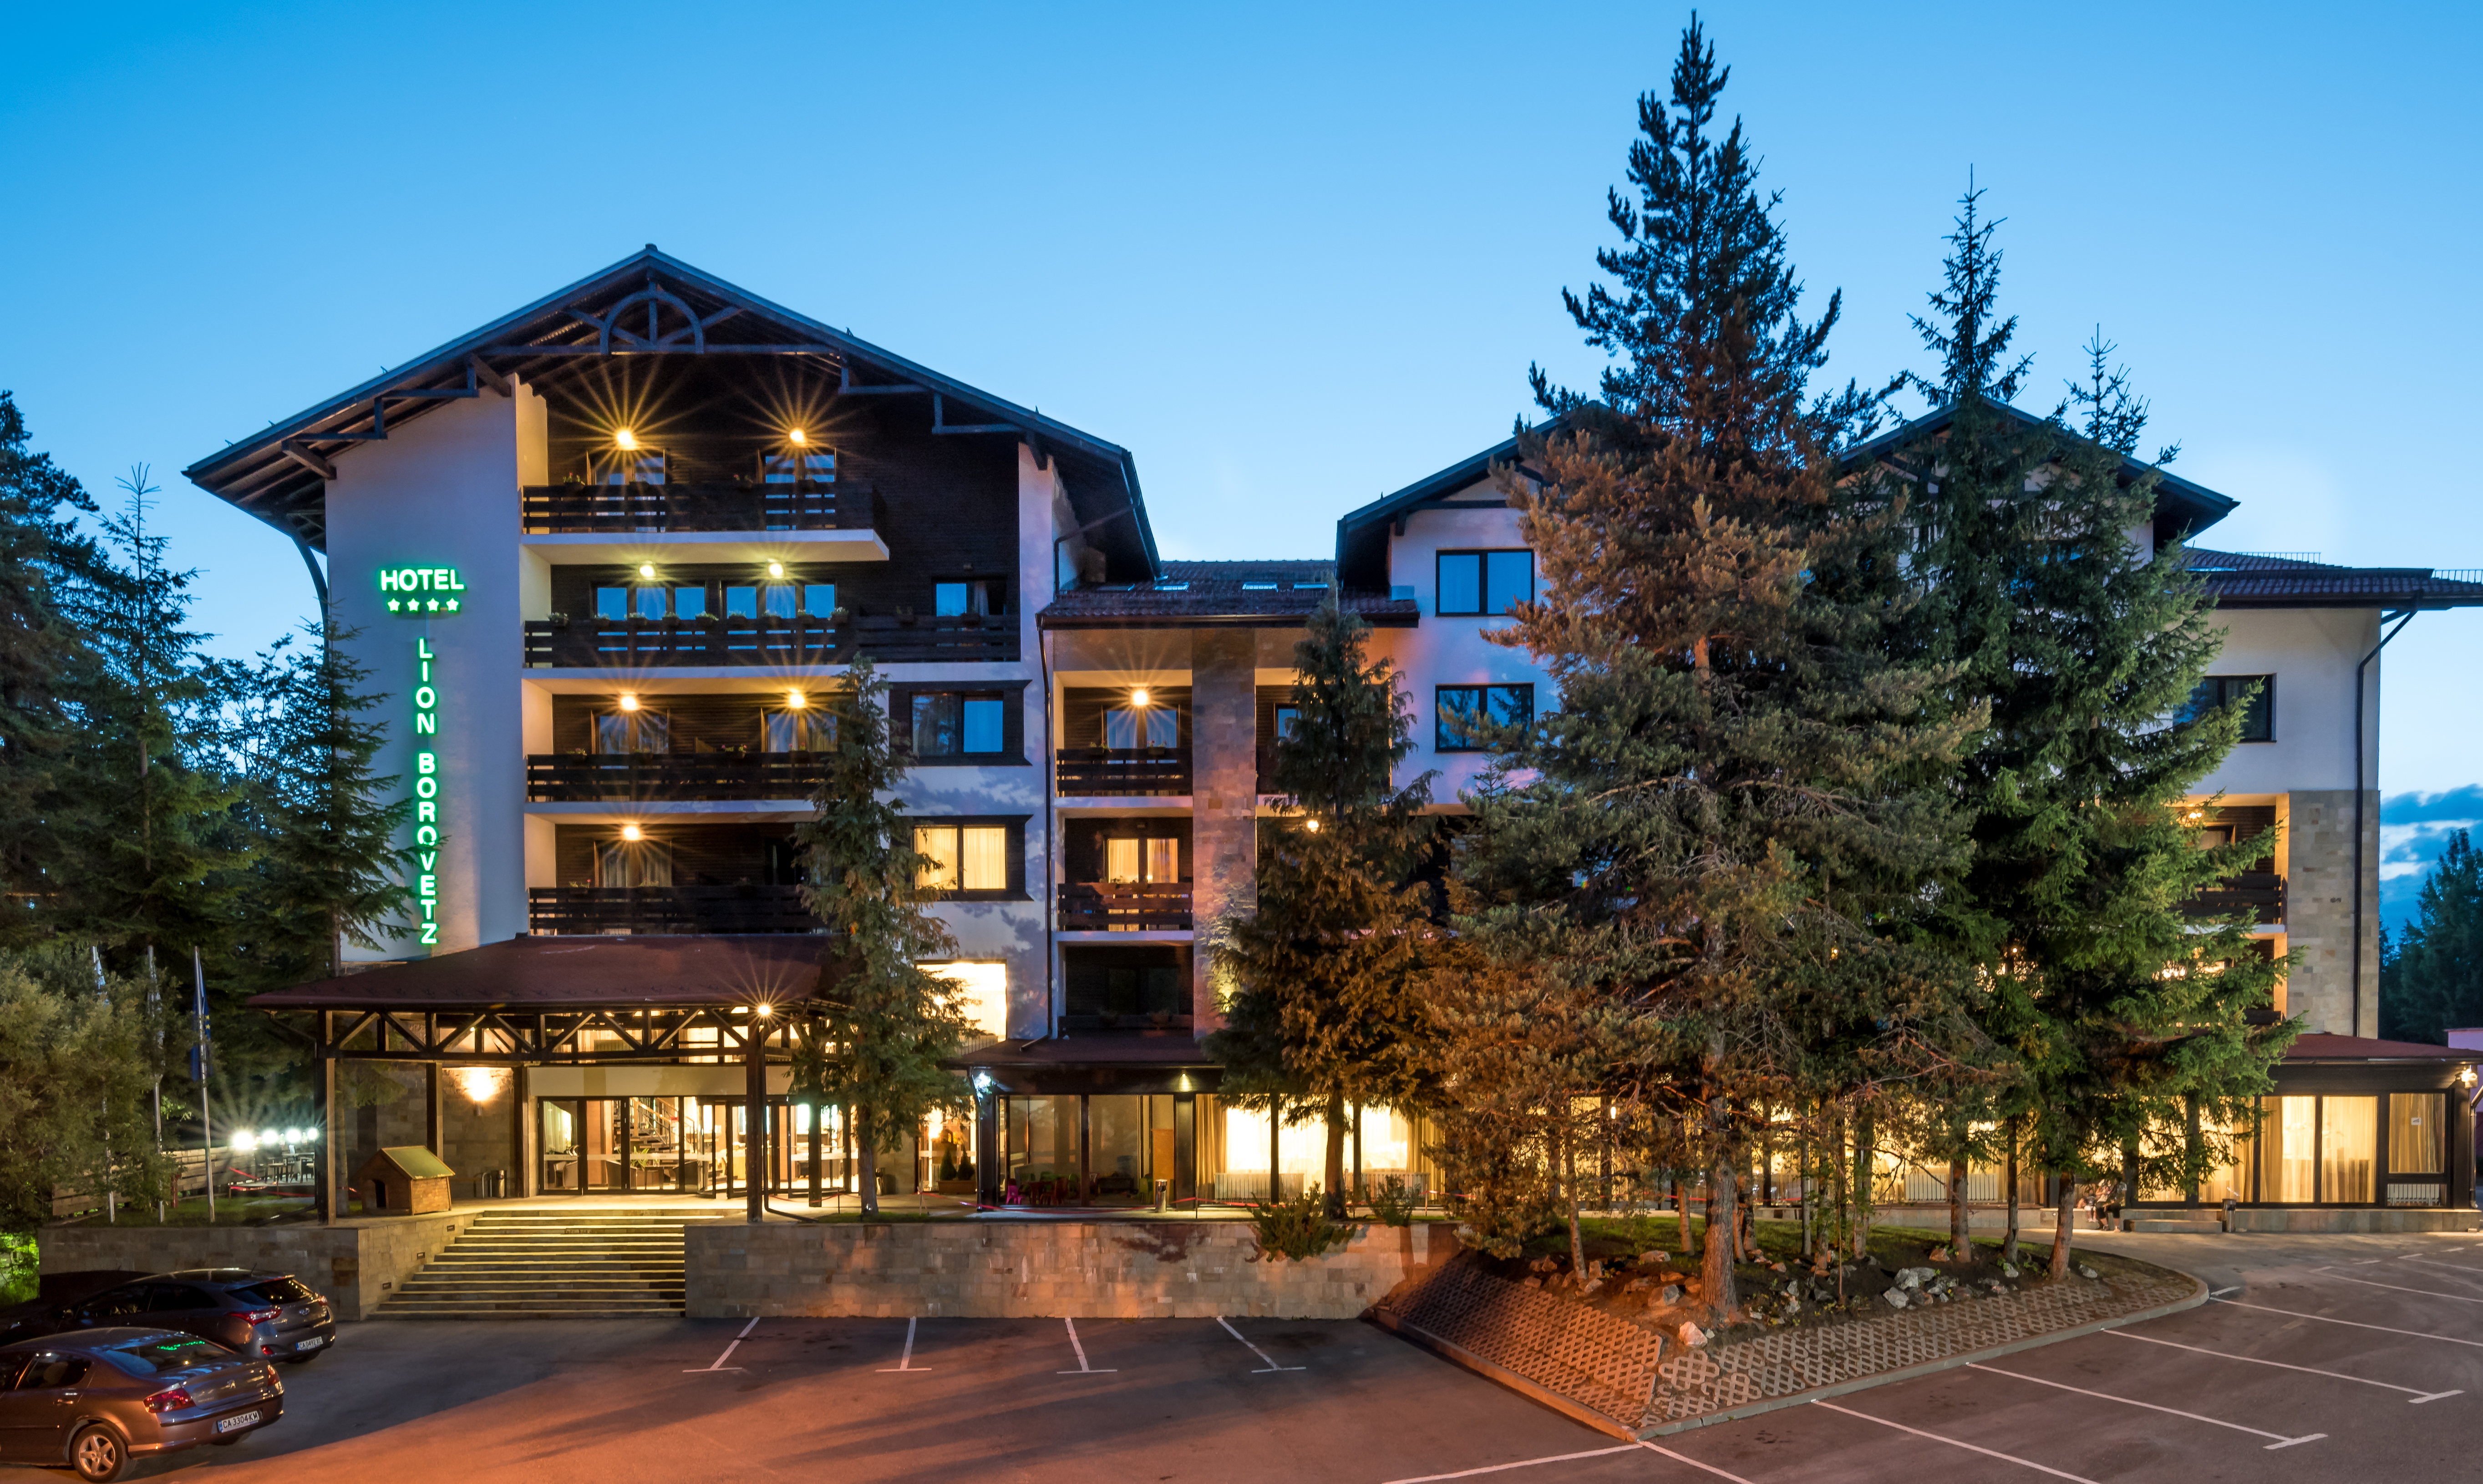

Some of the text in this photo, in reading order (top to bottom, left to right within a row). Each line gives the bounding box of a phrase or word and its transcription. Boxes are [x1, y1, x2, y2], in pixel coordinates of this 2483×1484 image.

[381, 568, 464, 591] HOTEL
[415, 638, 437, 944] LION BOROVETZ
[223, 1412, 258, 1428] CA 3304 KM
